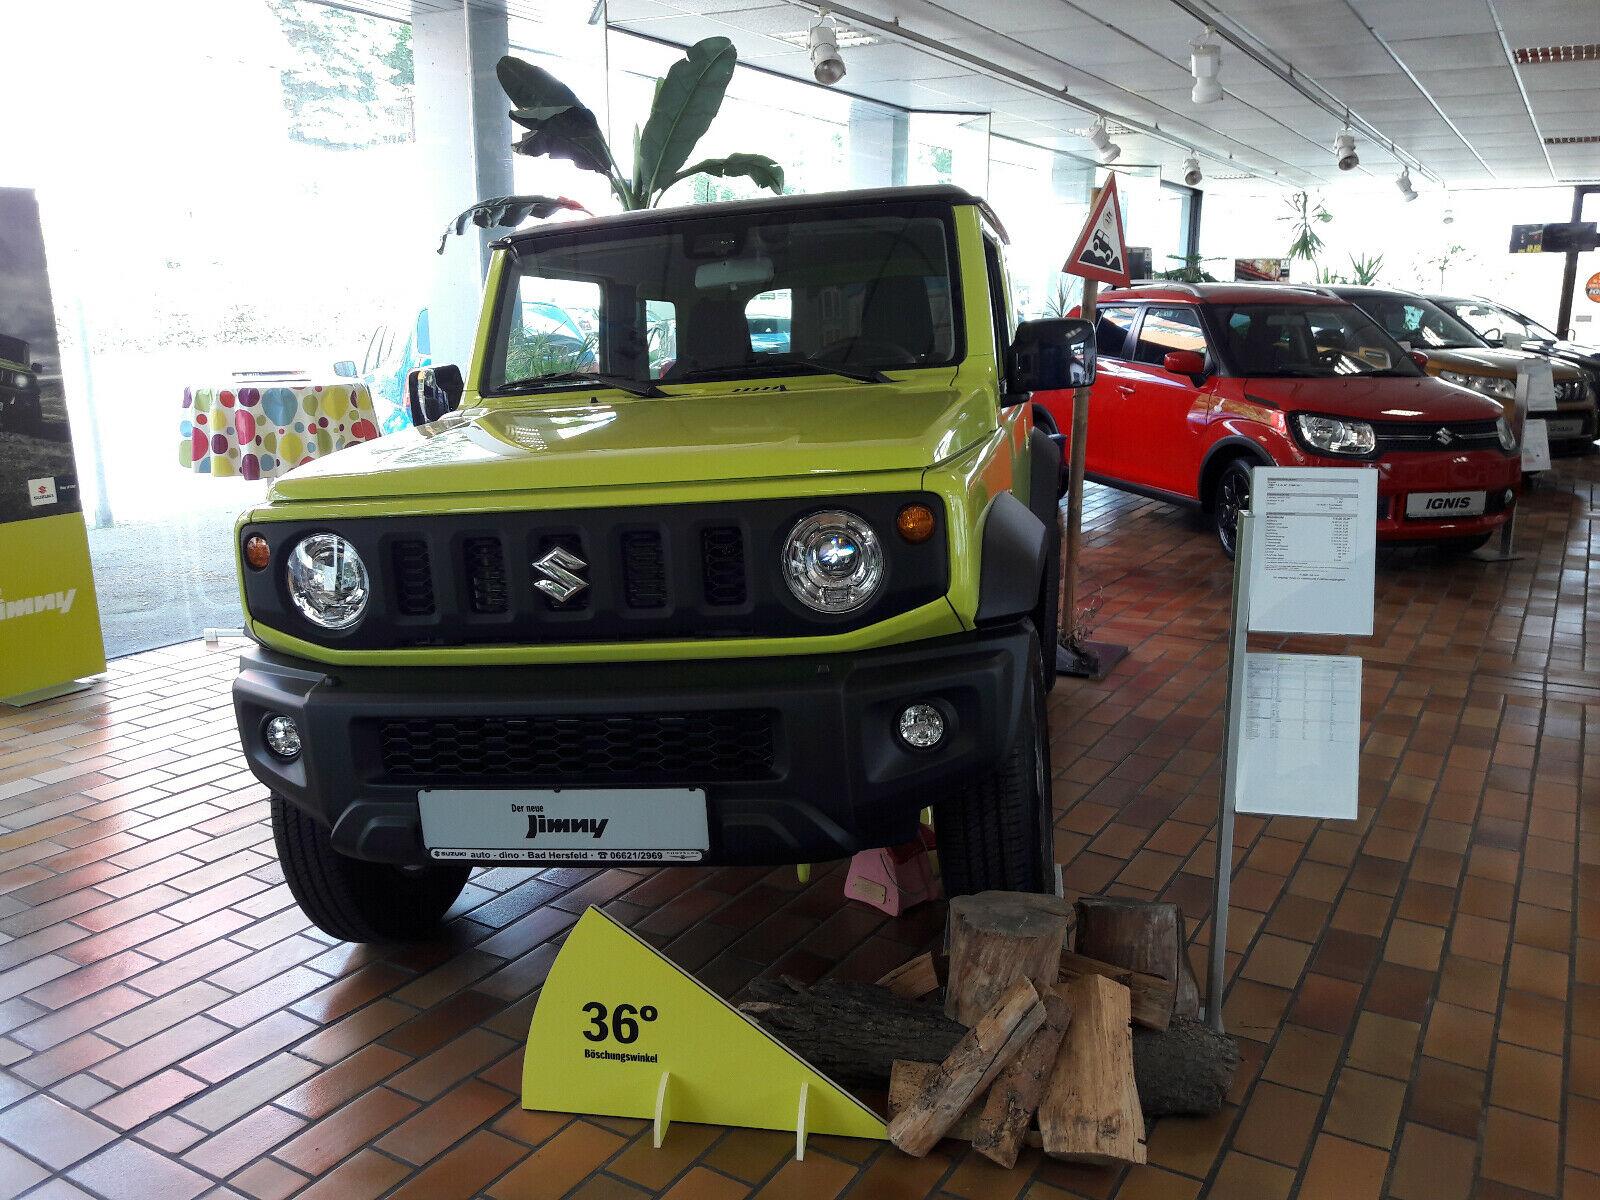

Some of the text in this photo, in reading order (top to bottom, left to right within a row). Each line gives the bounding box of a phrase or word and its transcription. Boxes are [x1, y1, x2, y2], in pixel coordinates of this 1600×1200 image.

[1426, 496, 1471, 510] IGNIS
[511, 803, 544, 813] Der neue
[525, 814, 609, 839] Jimny
[470, 851, 491, 859] auto
[498, 851, 519, 859] dino
[527, 851, 546, 859] Bad
[548, 851, 588, 860] Hersfeld
[610, 851, 663, 860] 06621/2969
[581, 1001, 658, 1044] 36°
[584, 1048, 658, 1063] Böschungswinkel
